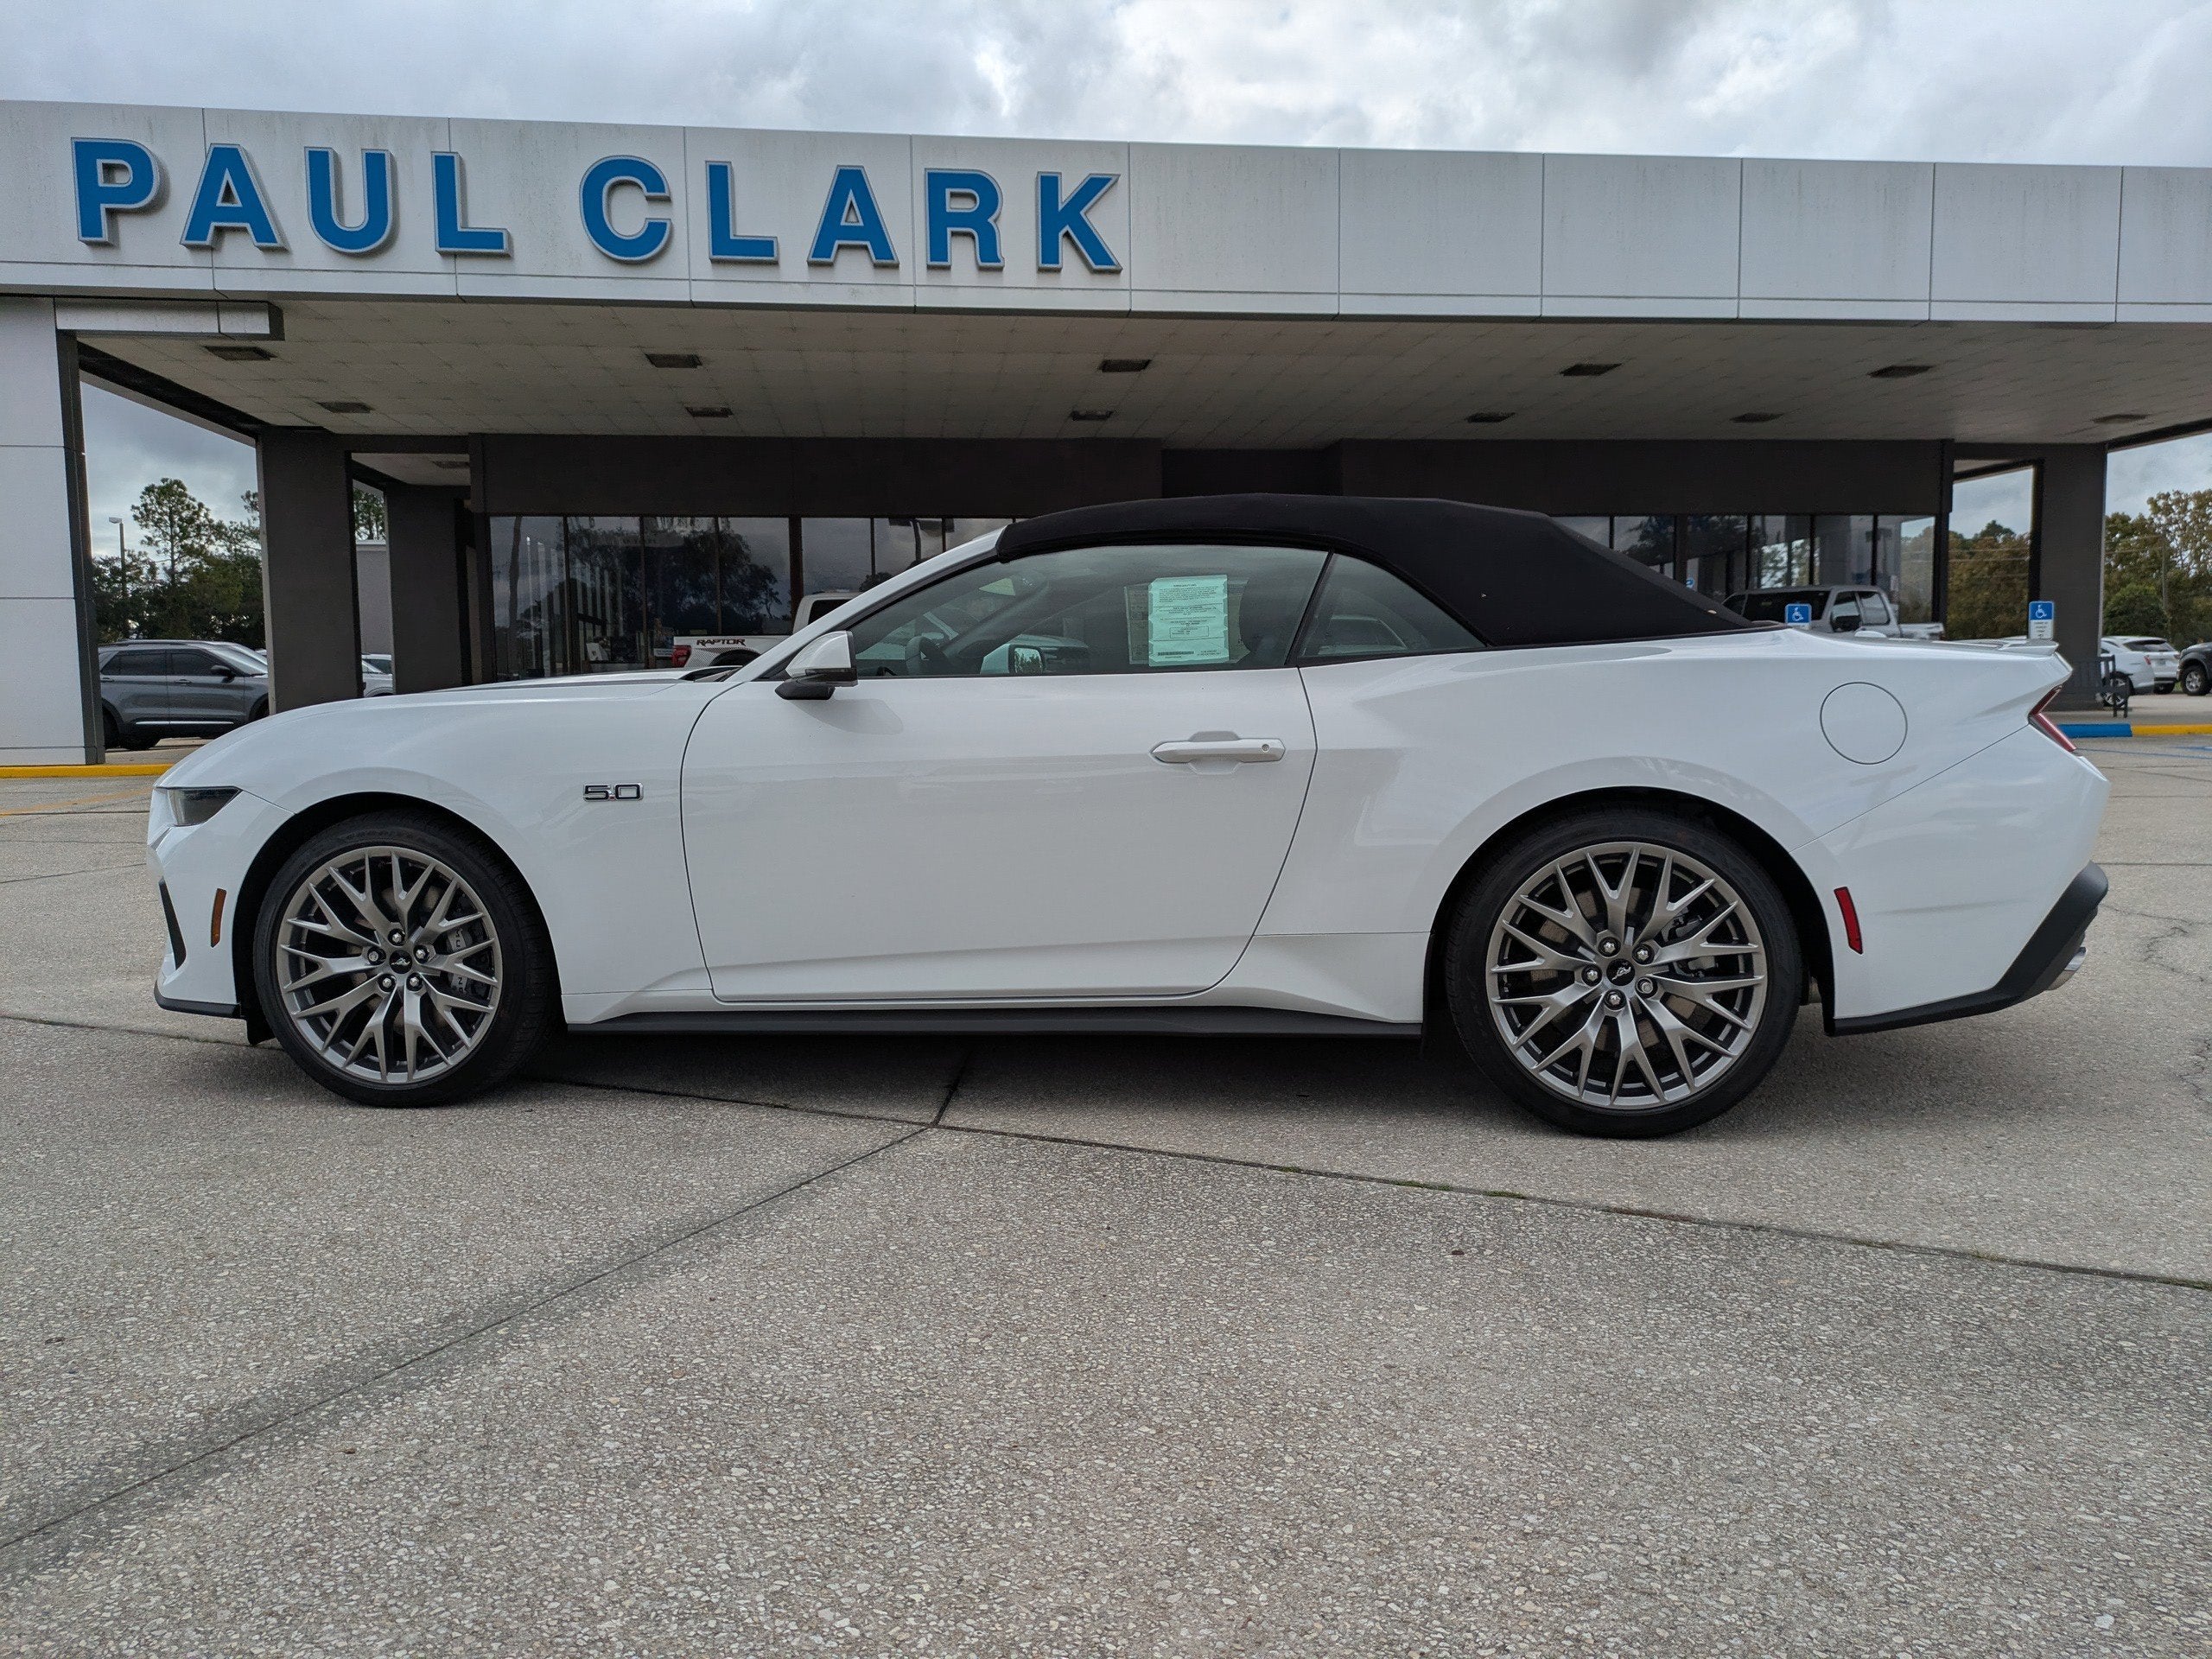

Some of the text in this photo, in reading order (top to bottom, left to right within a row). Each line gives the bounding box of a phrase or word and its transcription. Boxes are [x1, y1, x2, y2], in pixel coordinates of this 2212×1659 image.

[72, 137, 1122, 273] PAUL CLARK
[583, 783, 644, 801] 5.0
